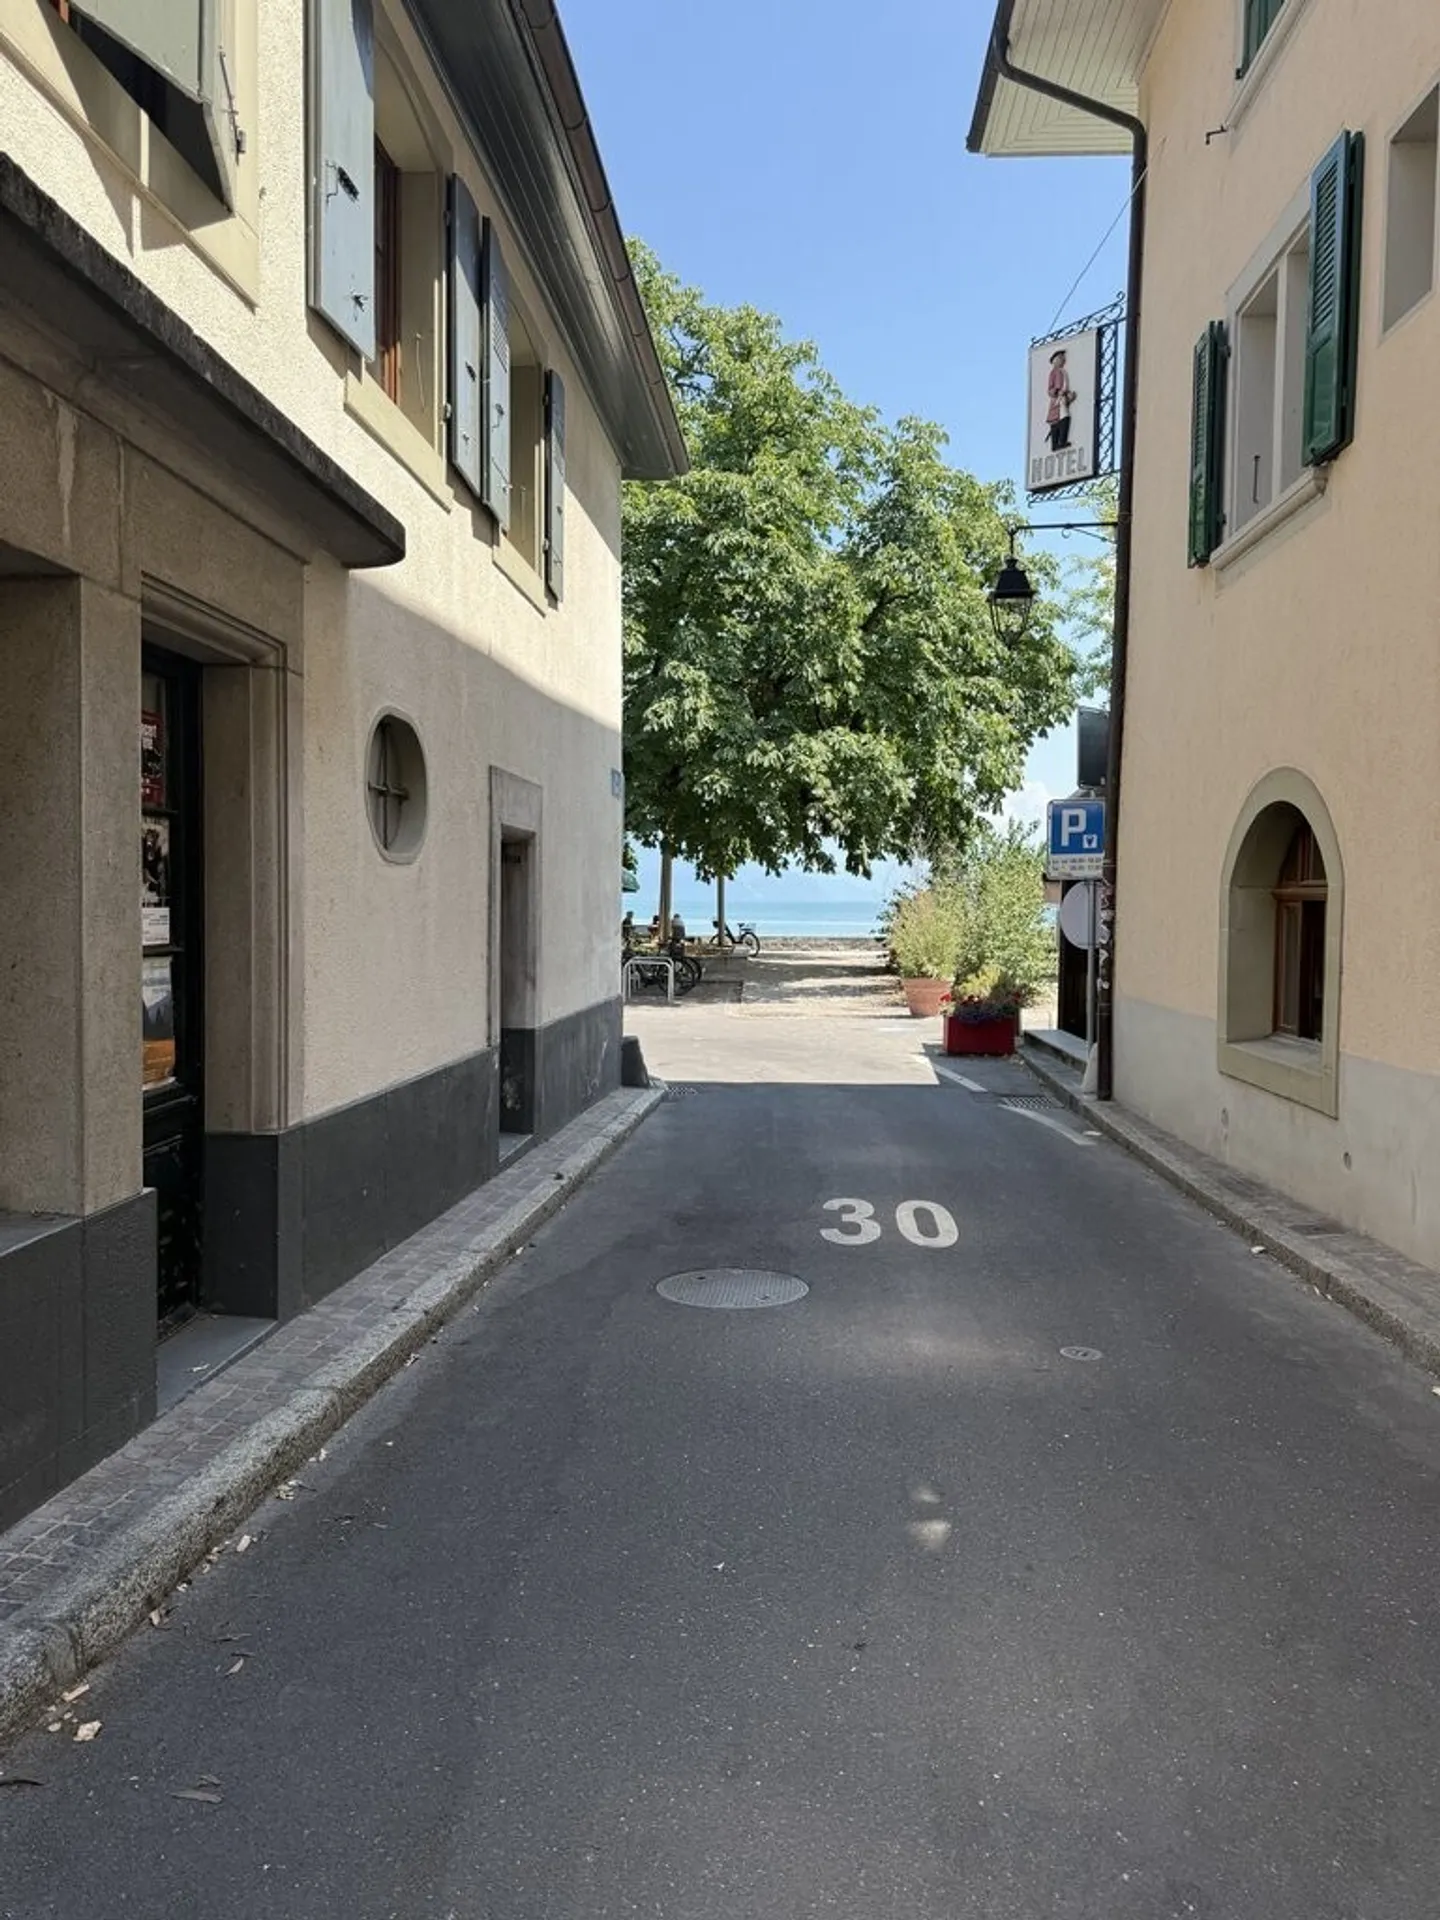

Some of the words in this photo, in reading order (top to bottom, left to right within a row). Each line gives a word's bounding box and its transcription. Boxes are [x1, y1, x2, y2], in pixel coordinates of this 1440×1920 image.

[1031, 446, 1088, 483] HOTEL
[1061, 809, 1087, 847] P
[819, 1197, 960, 1248] 30
